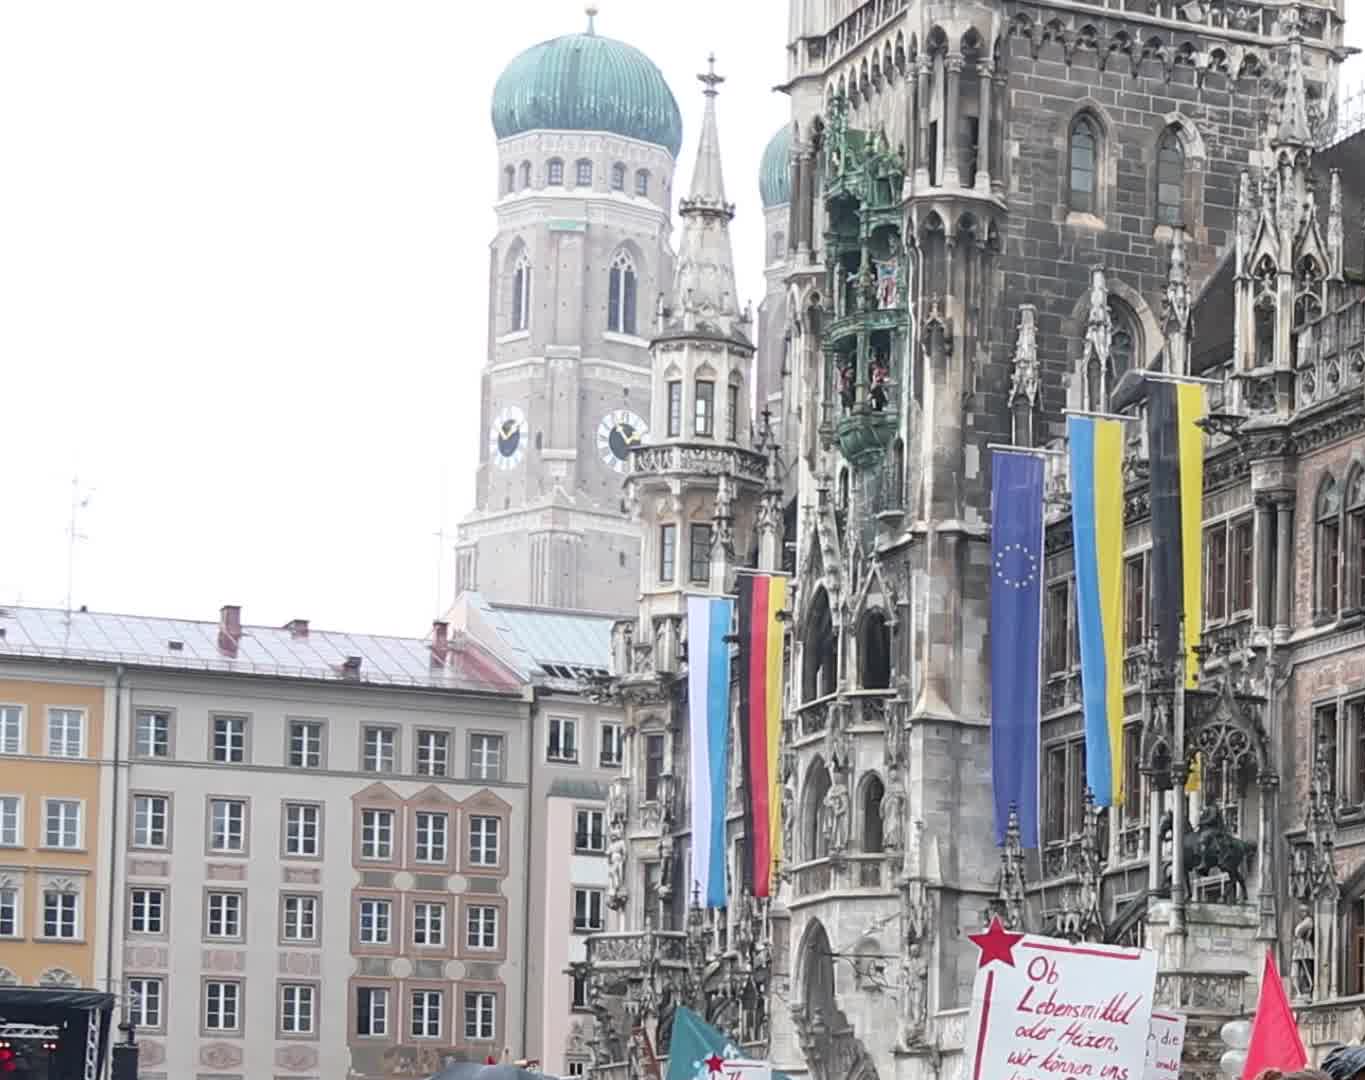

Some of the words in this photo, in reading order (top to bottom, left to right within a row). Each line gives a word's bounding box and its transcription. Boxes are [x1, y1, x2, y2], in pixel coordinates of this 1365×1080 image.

[1027, 956, 1059, 985] Ob
[1015, 1018, 1055, 1041] oder
[1007, 1047, 1038, 1066] wir
